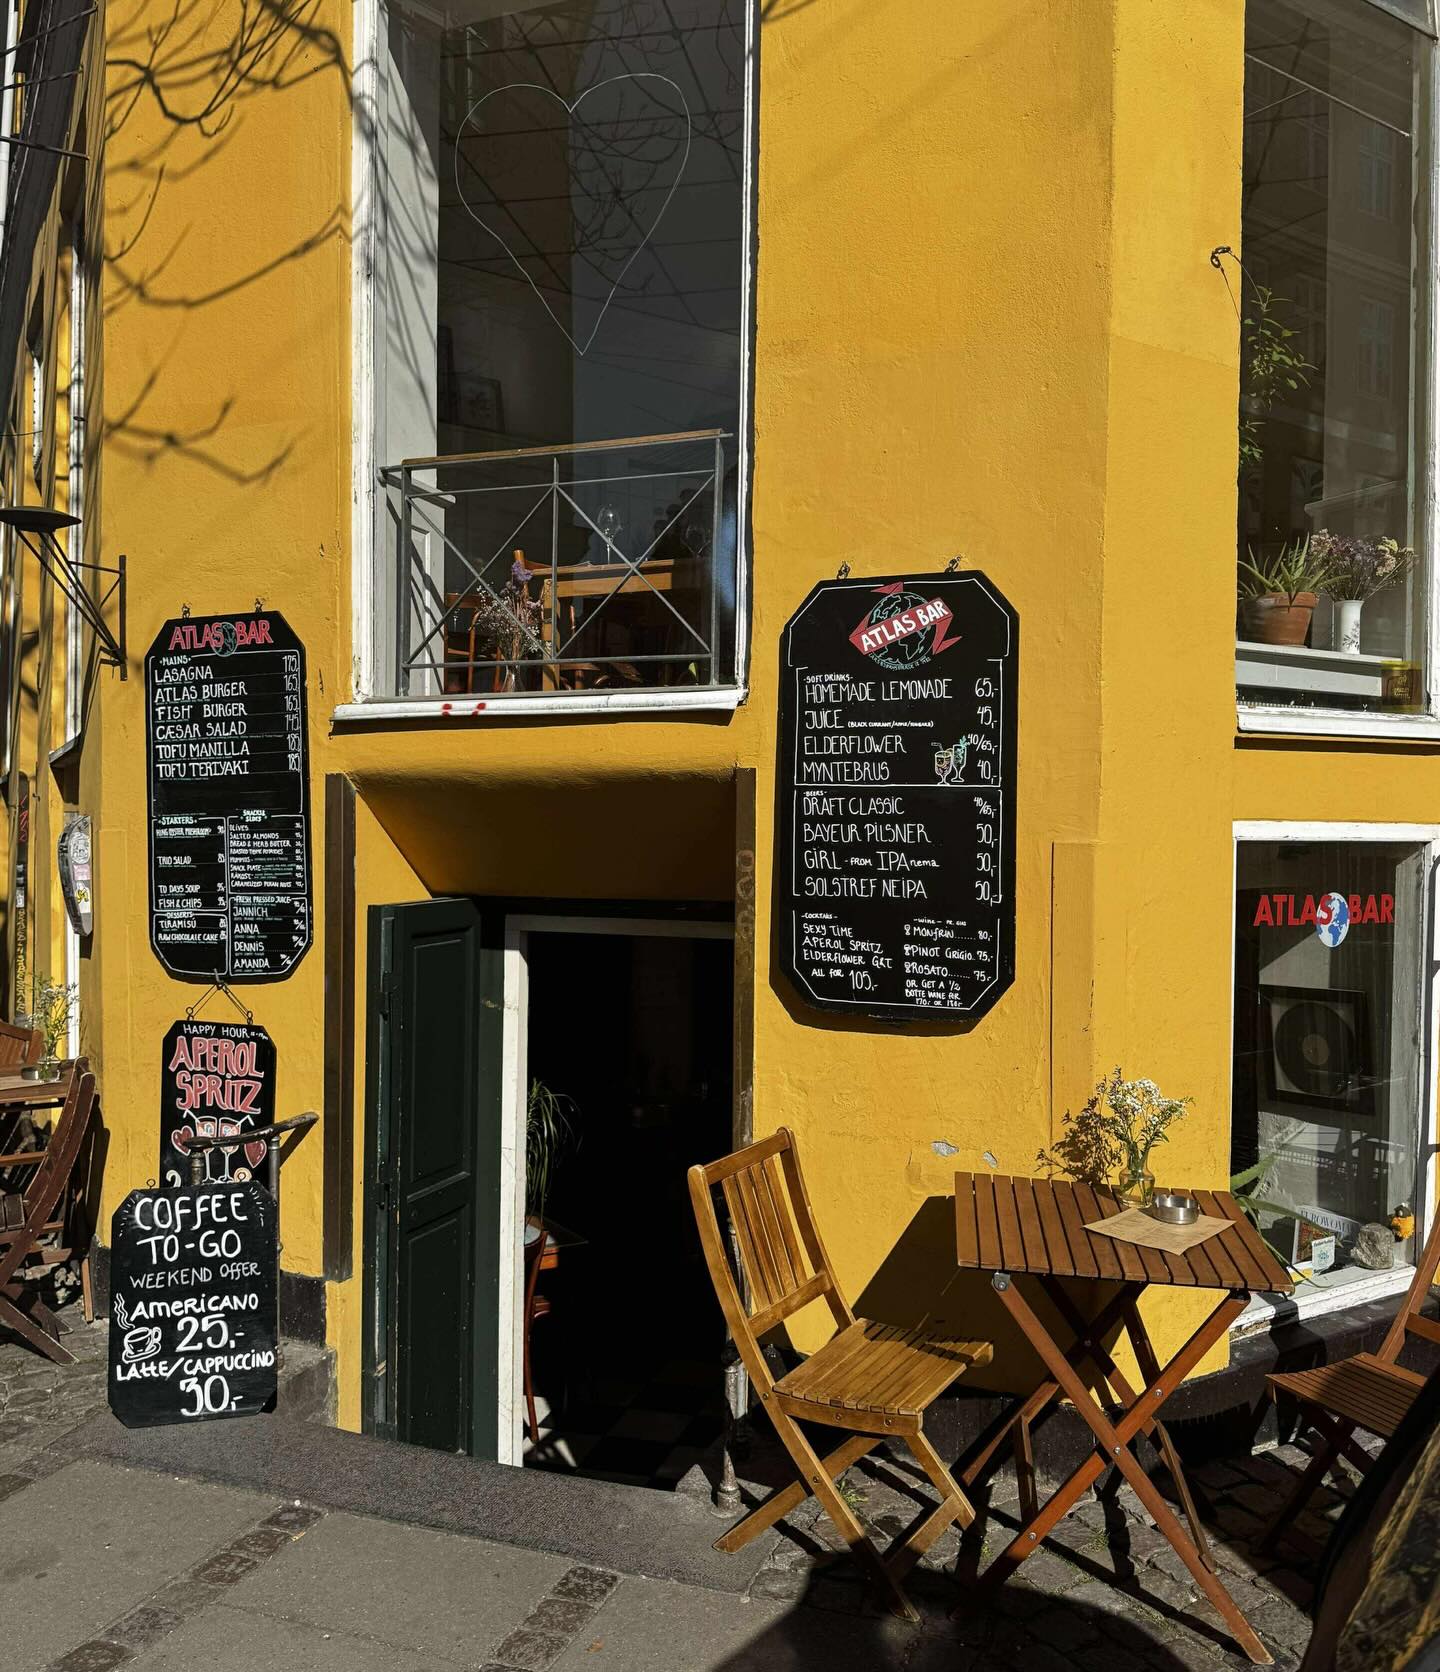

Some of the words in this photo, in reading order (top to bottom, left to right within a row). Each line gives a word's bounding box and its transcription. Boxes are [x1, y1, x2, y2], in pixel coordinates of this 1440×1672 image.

[861, 613, 916, 651] ATLAS
[916, 600, 949, 625] BAR
[169, 622, 225, 650] ATLAS
[235, 620, 274, 645] BAR
[155, 666, 213, 683] LASAGNA
[155, 686, 197, 703] ATLAS
[202, 682, 248, 699] BURGER
[805, 682, 876, 703] HOMEMADE
[881, 679, 953, 700] LEMONADE
[155, 705, 193, 720] FISH
[203, 703, 248, 718] BURGER
[156, 724, 201, 739] CÆSAR
[206, 721, 247, 736] SALAD
[156, 744, 186, 759] TOFU
[189, 741, 250, 757] MANILLA
[804, 735, 907, 755] ELDERFLOWER
[156, 763, 186, 778] TOFU
[189, 760, 249, 777] TERIYAKI
[803, 761, 890, 782] MYNTEBRUS
[803, 797, 846, 816] DRAFT
[230, 832, 251, 840] SALTED
[803, 823, 862, 843] BAYEUR
[173, 856, 192, 865] SALAD
[804, 876, 878, 898] SOLSTREF
[158, 899, 175, 908] FISH
[181, 898, 202, 908] CHIPS
[1253, 894, 1333, 927] ATLAS
[1349, 894, 1394, 925] BAR
[234, 923, 260, 934] ANNA
[802, 922, 827, 936] SEXY
[802, 935, 845, 951] APEROL
[233, 958, 270, 968] AMANDA
[911, 961, 949, 977] ROSATO
[906, 979, 918, 988] OR
[921, 979, 936, 989] GET
[938, 981, 945, 989] A
[183, 1024, 216, 1036] HAPPY
[222, 1027, 250, 1038] HOUR
[169, 1036, 264, 1078] APEROL
[130, 1267, 213, 1289] WEEKEND
